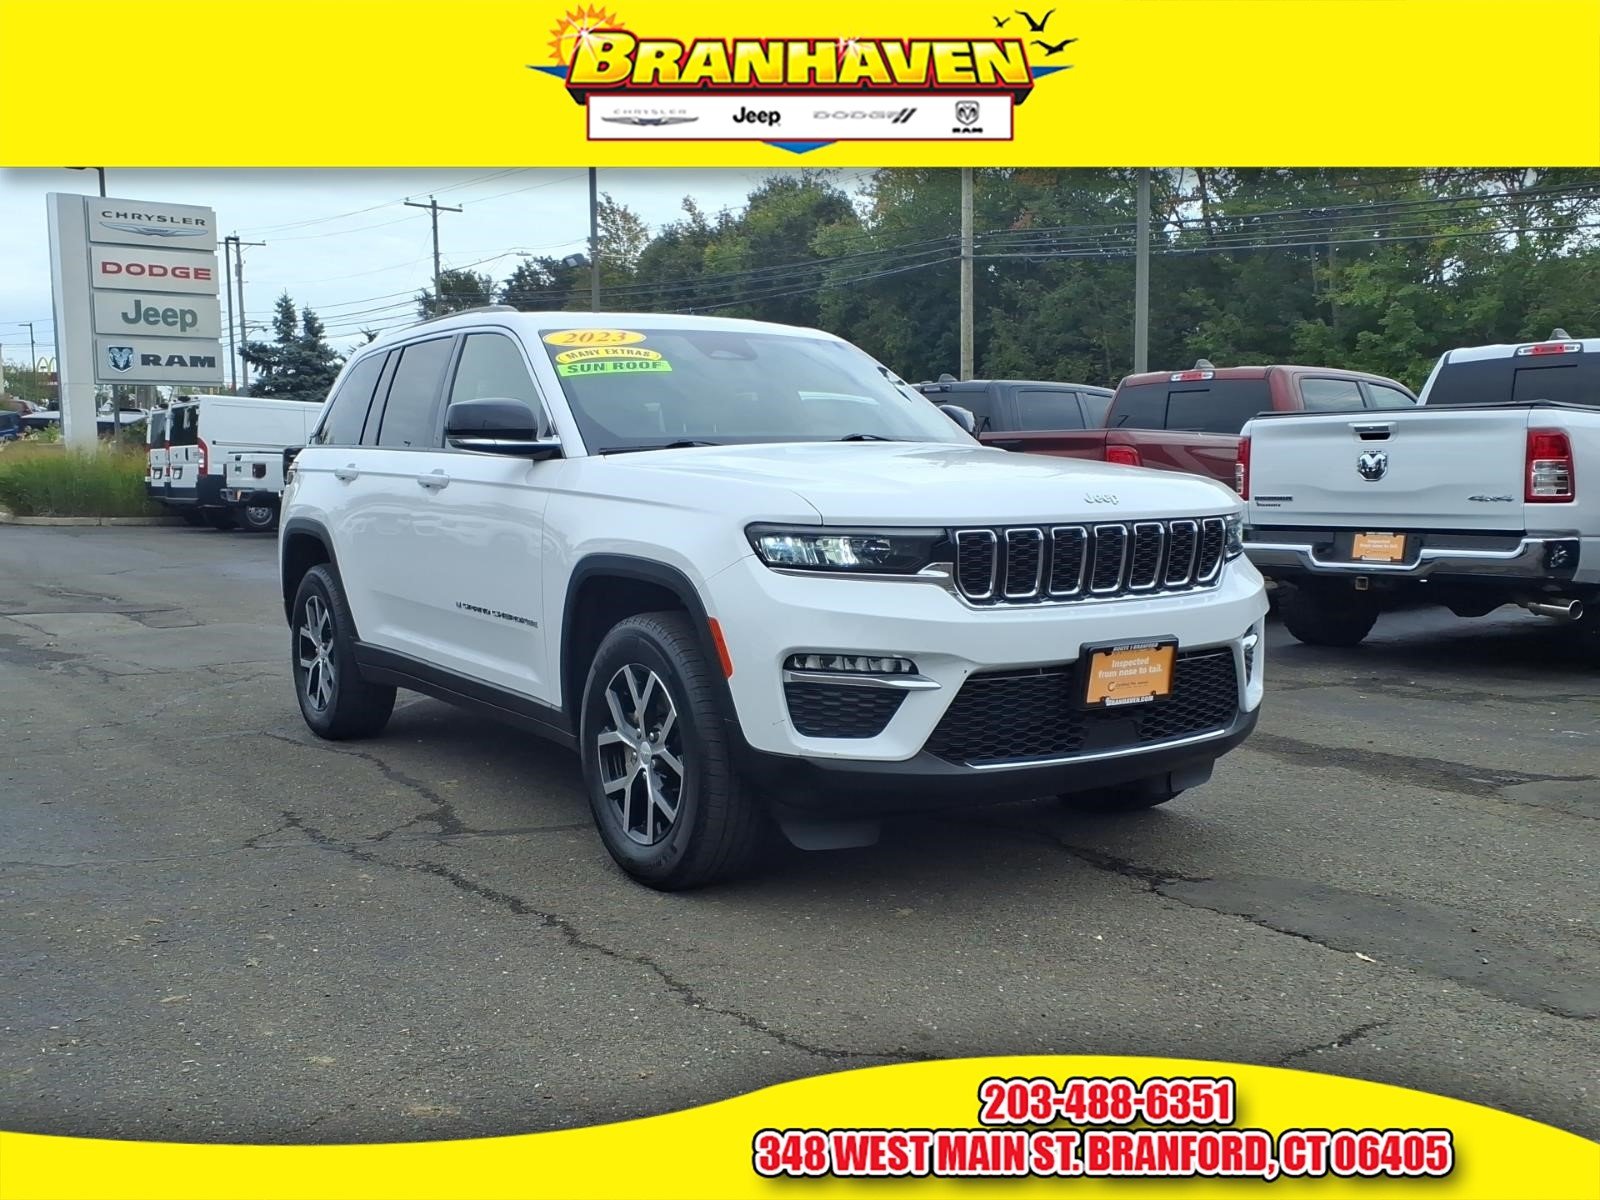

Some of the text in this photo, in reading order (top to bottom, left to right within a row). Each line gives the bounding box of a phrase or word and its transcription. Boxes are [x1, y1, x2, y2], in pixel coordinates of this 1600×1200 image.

[101, 210, 206, 226] CHRYSLER
[101, 261, 212, 281] DODGE
[121, 299, 198, 332] Jeep
[562, 331, 627, 343] 2023
[565, 347, 651, 359] MANY EXTRAS
[140, 353, 216, 368] RAM
[567, 361, 662, 373] SUN ROOF
[1083, 492, 1119, 505] Jeep
[1111, 656, 1150, 668] Inspected
[1099, 670, 1117, 678] from
[1119, 668, 1137, 676] nose
